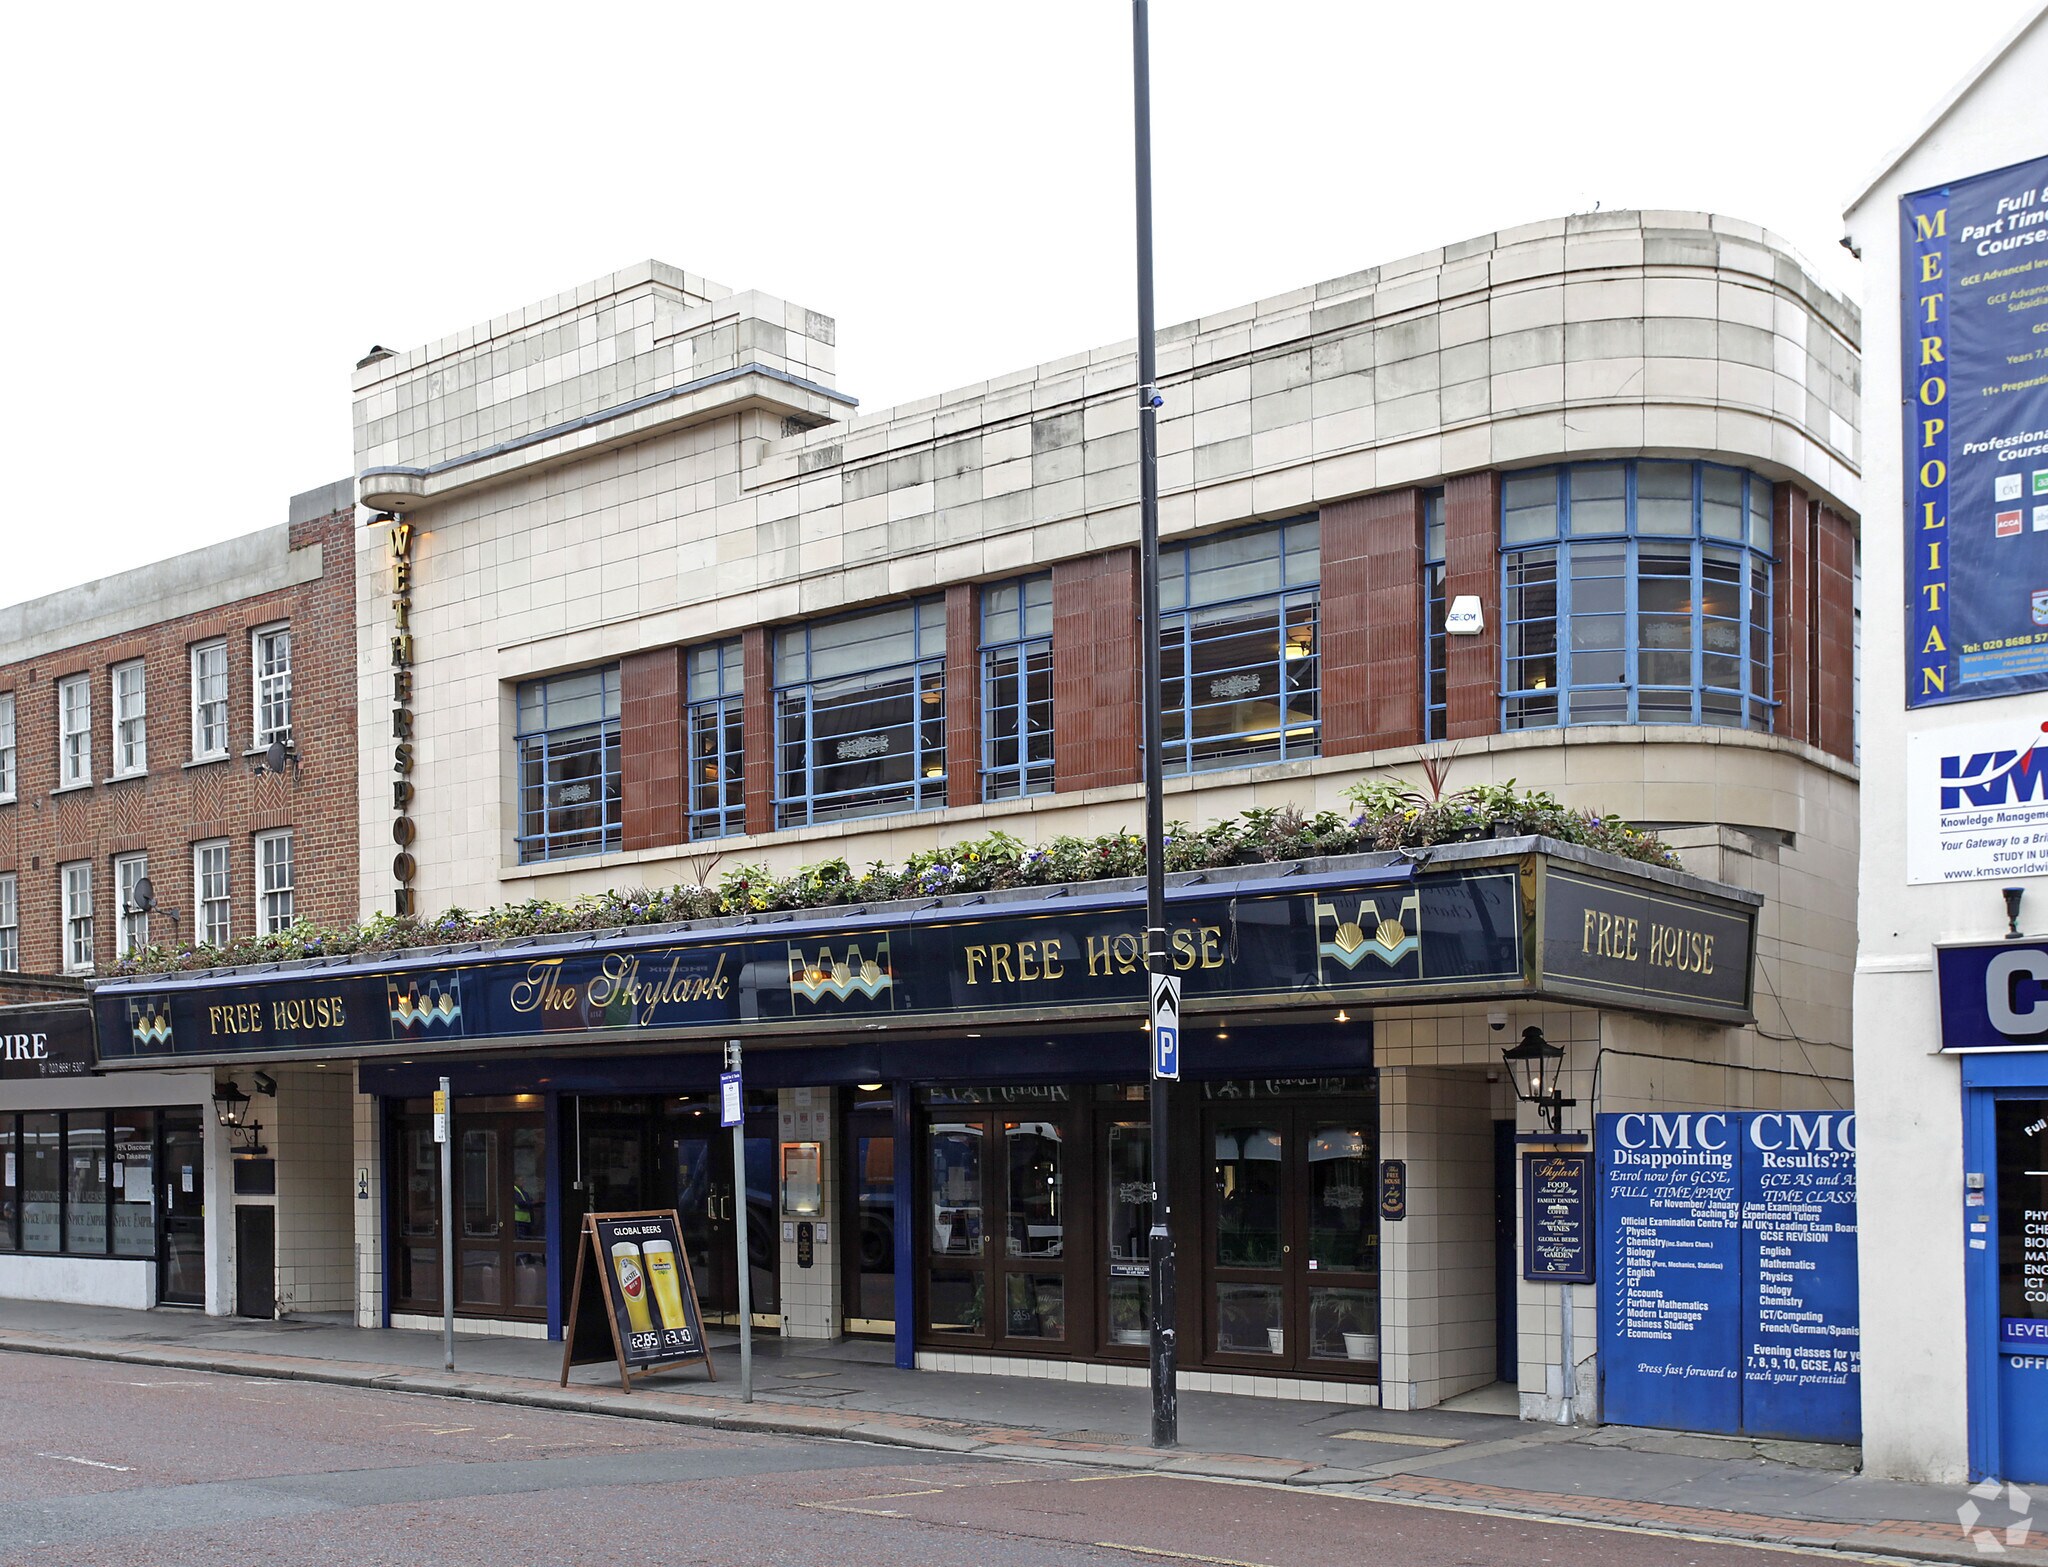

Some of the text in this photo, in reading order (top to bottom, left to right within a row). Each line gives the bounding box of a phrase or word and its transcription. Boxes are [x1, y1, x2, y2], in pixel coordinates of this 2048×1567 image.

[1997, 189, 2036, 215] Full
[1961, 218, 2004, 243] Part
[1976, 229, 2048, 257] Course
[1961, 260, 2032, 286] GCE Advanced
[1987, 292, 2007, 305] GCE
[2006, 352, 2034, 364] Years
[1982, 386, 1999, 396] 11+
[1915, 208, 1947, 696] METROPOLITAN
[2001, 484, 2020, 495] CAT
[1998, 518, 2020, 529] ACCA
[1450, 613, 1476, 621] SECOM
[1962, 643, 1981, 655] Tel:
[1983, 640, 2003, 652] 020
[2005, 635, 2033, 648] 8688
[389, 524, 416, 917] WETHERSPOON
[1941, 814, 1994, 828] Knowledge
[1941, 841, 1963, 851] Your
[1965, 838, 2008, 849] Gateway
[2010, 836, 2020, 845] to
[2023, 836, 2029, 844] a
[1993, 851, 2024, 862] STUDY
[2026, 850, 2036, 859] IN
[1582, 908, 1716, 975] FREE HOUSE
[964, 938, 1064, 985] FREE
[510, 952, 730, 1027] The Skylark
[209, 996, 345, 1035] FREE HOUSE
[0, 1033, 48, 1060] IRE
[1161, 1031, 1174, 1067] P
[1616, 1114, 1726, 1150] CMC
[2024, 1119, 2047, 1136] Full
[1549, 1158, 1565, 1167] The
[1613, 1149, 1732, 1169] Disappointing
[1535, 1166, 1579, 1180] Skylark
[1610, 1169, 1643, 1181] Enrol
[1644, 1173, 1669, 1181] now
[1669, 1170, 1687, 1185] for
[1691, 1171, 1730, 1185] GCSE,
[1760, 1174, 1791, 1188] GCE
[1793, 1174, 1813, 1186] AS
[1816, 1173, 1841, 1185] and
[1611, 1186, 1649, 1198] FULL
[1654, 1186, 1734, 1200] TIME/PART
[1763, 1190, 1803, 1202] TIME
[1650, 1199, 1662, 1207] For
[1665, 1199, 1706, 1208] November/
[1708, 1201, 1739, 1211] January
[1768, 1203, 1822, 1212] Examinations
[1691, 1209, 1820, 1221] Coaching By Experienced Tutors
[613, 1225, 662, 1236] GLOBAL BEERS
[1621, 1217, 1647, 1225] Official
[1649, 1218, 1695, 1227] Examination
[1697, 1219, 1722, 1228] Centre
[1725, 1220, 1738, 1228] For
[1742, 1221, 1753, 1229] All
[1755, 1221, 1773, 1230] UK's
[1775, 1222, 1808, 1232] Leading
[1810, 1223, 1833, 1232] Exam
[1626, 1227, 1656, 1238] Physics
[1760, 1231, 1829, 1242] GCSE REVISION
[1626, 1247, 1655, 1259] Biology
[1760, 1246, 1791, 1257] English
[1626, 1258, 1650, 1267] Maths
[1760, 1259, 1816, 1270] Mathematics
[623, 1270, 638, 1284] AMSTEL
[1627, 1268, 1655, 1278] English
[1760, 1271, 1794, 1283] Physics
[1627, 1278, 1640, 1287] ICT
[2025, 1278, 2044, 1288] ICT
[1627, 1288, 1663, 1298] Accounts
[1760, 1284, 1792, 1296] Biology
[1627, 1298, 1709, 1311] Further Mathematics
[1760, 1296, 1803, 1308] Chemistry
[1627, 1308, 1702, 1321] Modern Languages
[1760, 1310, 1823, 1323] ICT/Computing
[1627, 1318, 1694, 1330] Business Studies
[632, 1332, 658, 1348] £2.85
[1754, 1344, 1792, 1358] Evening
[1794, 1346, 1831, 1358] classes
[1833, 1348, 1847, 1358] for
[1747, 1357, 1848, 1373] 7, 8, 9, 10, GCSE, AS
[1638, 1363, 1849, 1386] Press fast forward to reach your potential
